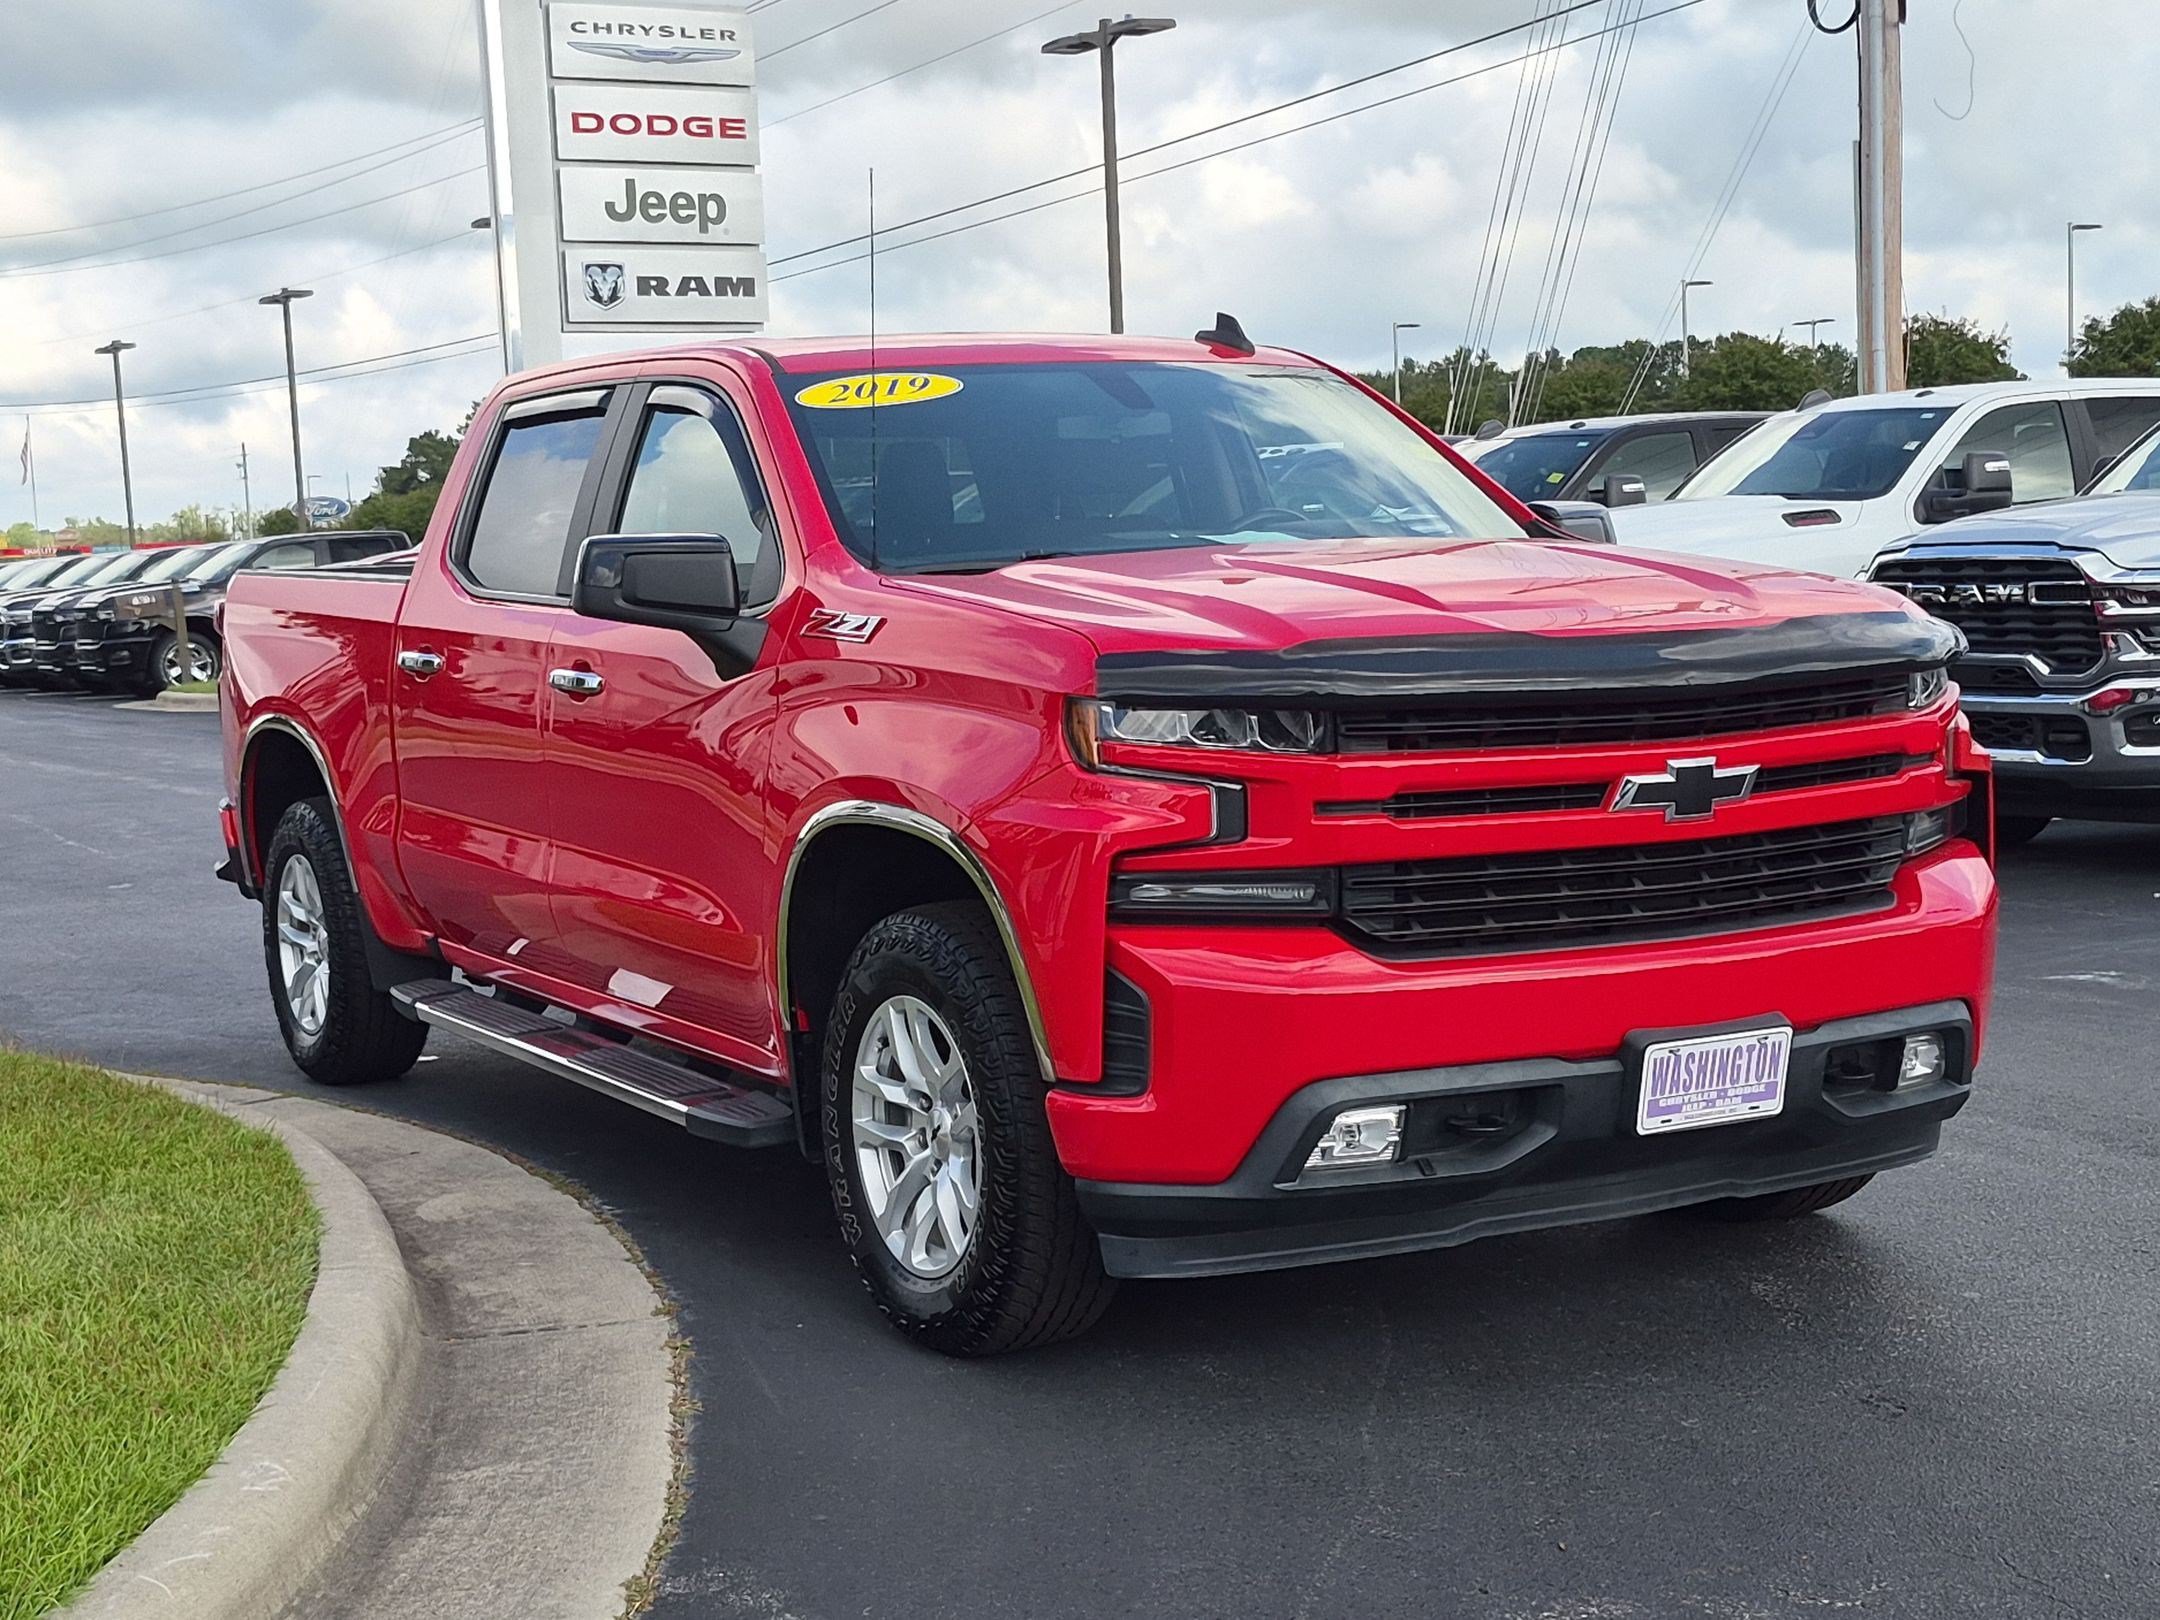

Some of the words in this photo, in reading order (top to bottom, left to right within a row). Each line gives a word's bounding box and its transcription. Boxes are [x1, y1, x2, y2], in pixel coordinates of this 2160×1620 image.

[570, 21, 737, 42] CHRYSLER
[571, 112, 748, 140] DODGE
[604, 178, 727, 235] Jeep
[636, 275, 756, 298] RAM
[828, 376, 931, 403] 2019
[305, 503, 339, 519] Ford
[1911, 584, 2025, 603] RAM
[800, 607, 888, 645] Z71
[1651, 1040, 1782, 1098] WASHINGTON
[1727, 1083, 1767, 1097] DODGE
